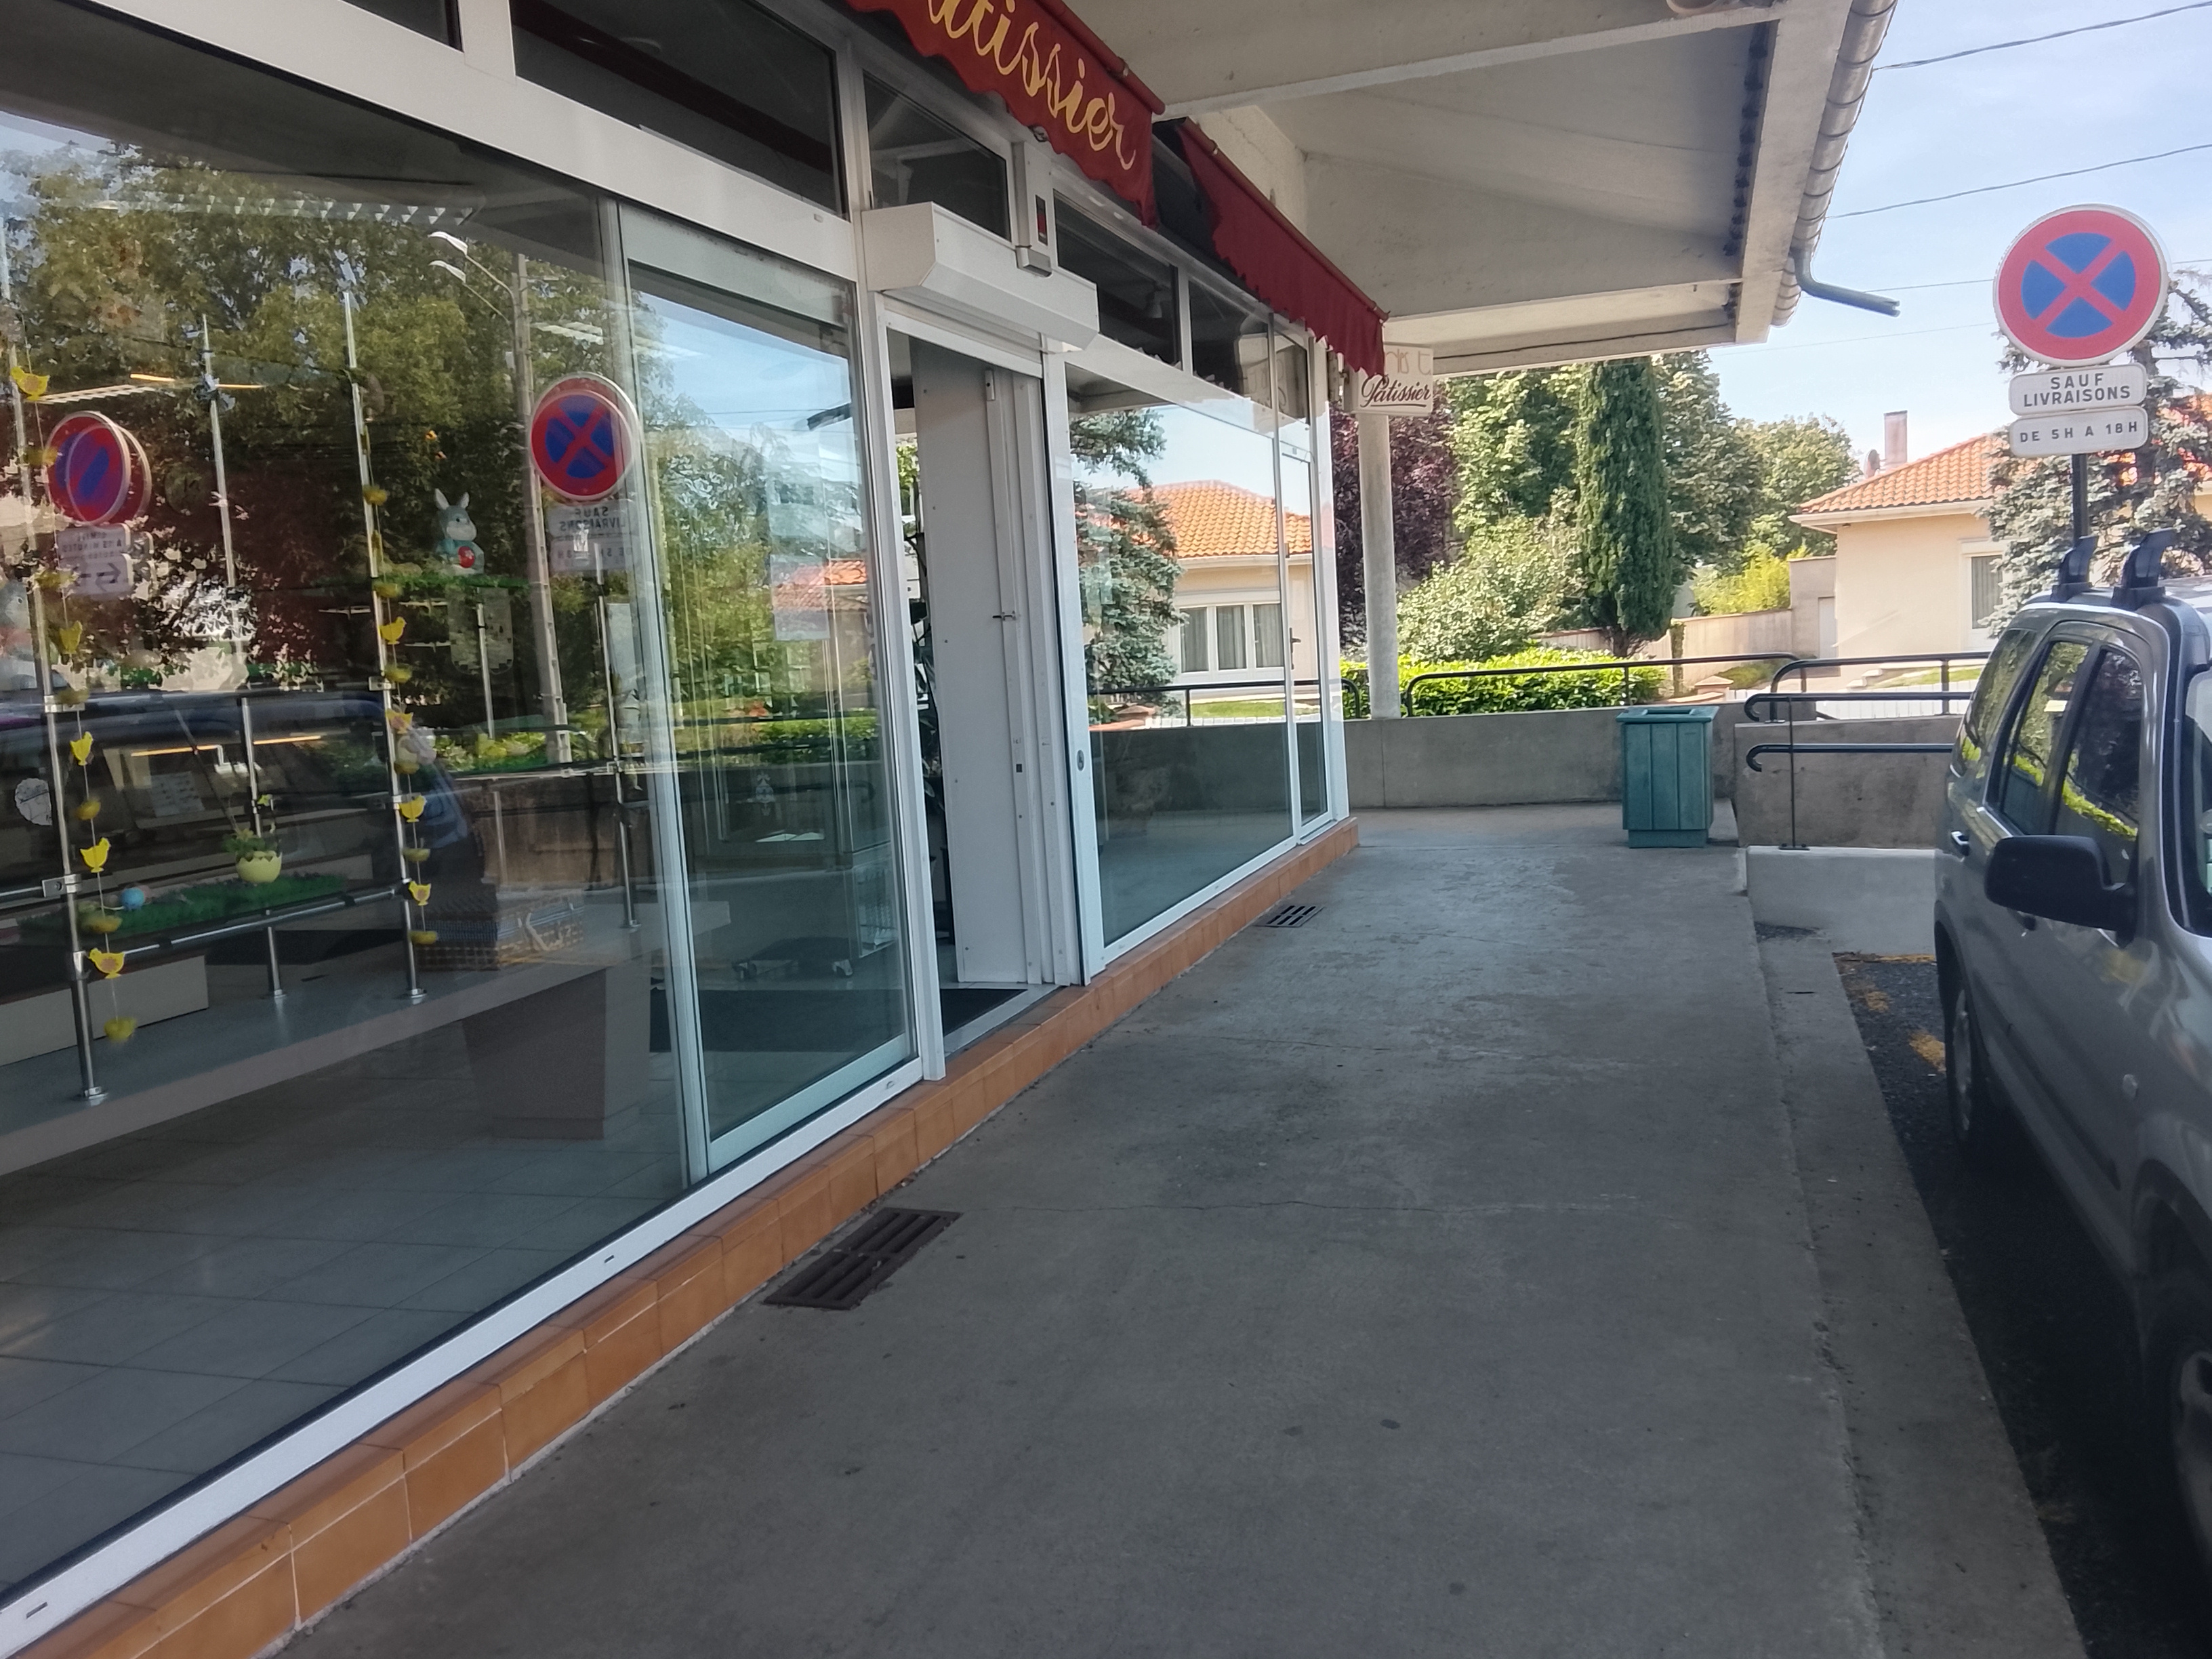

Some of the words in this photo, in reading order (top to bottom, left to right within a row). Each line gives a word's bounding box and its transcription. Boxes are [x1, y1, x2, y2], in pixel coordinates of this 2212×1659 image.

[2050, 373, 2104, 390] SAUF
[2024, 386, 2131, 407] LIVRAISONS
[2020, 431, 2040, 443] DE
[2051, 428, 2074, 439] 5H
[2085, 426, 2094, 437] A
[2106, 421, 2137, 434] 18H
